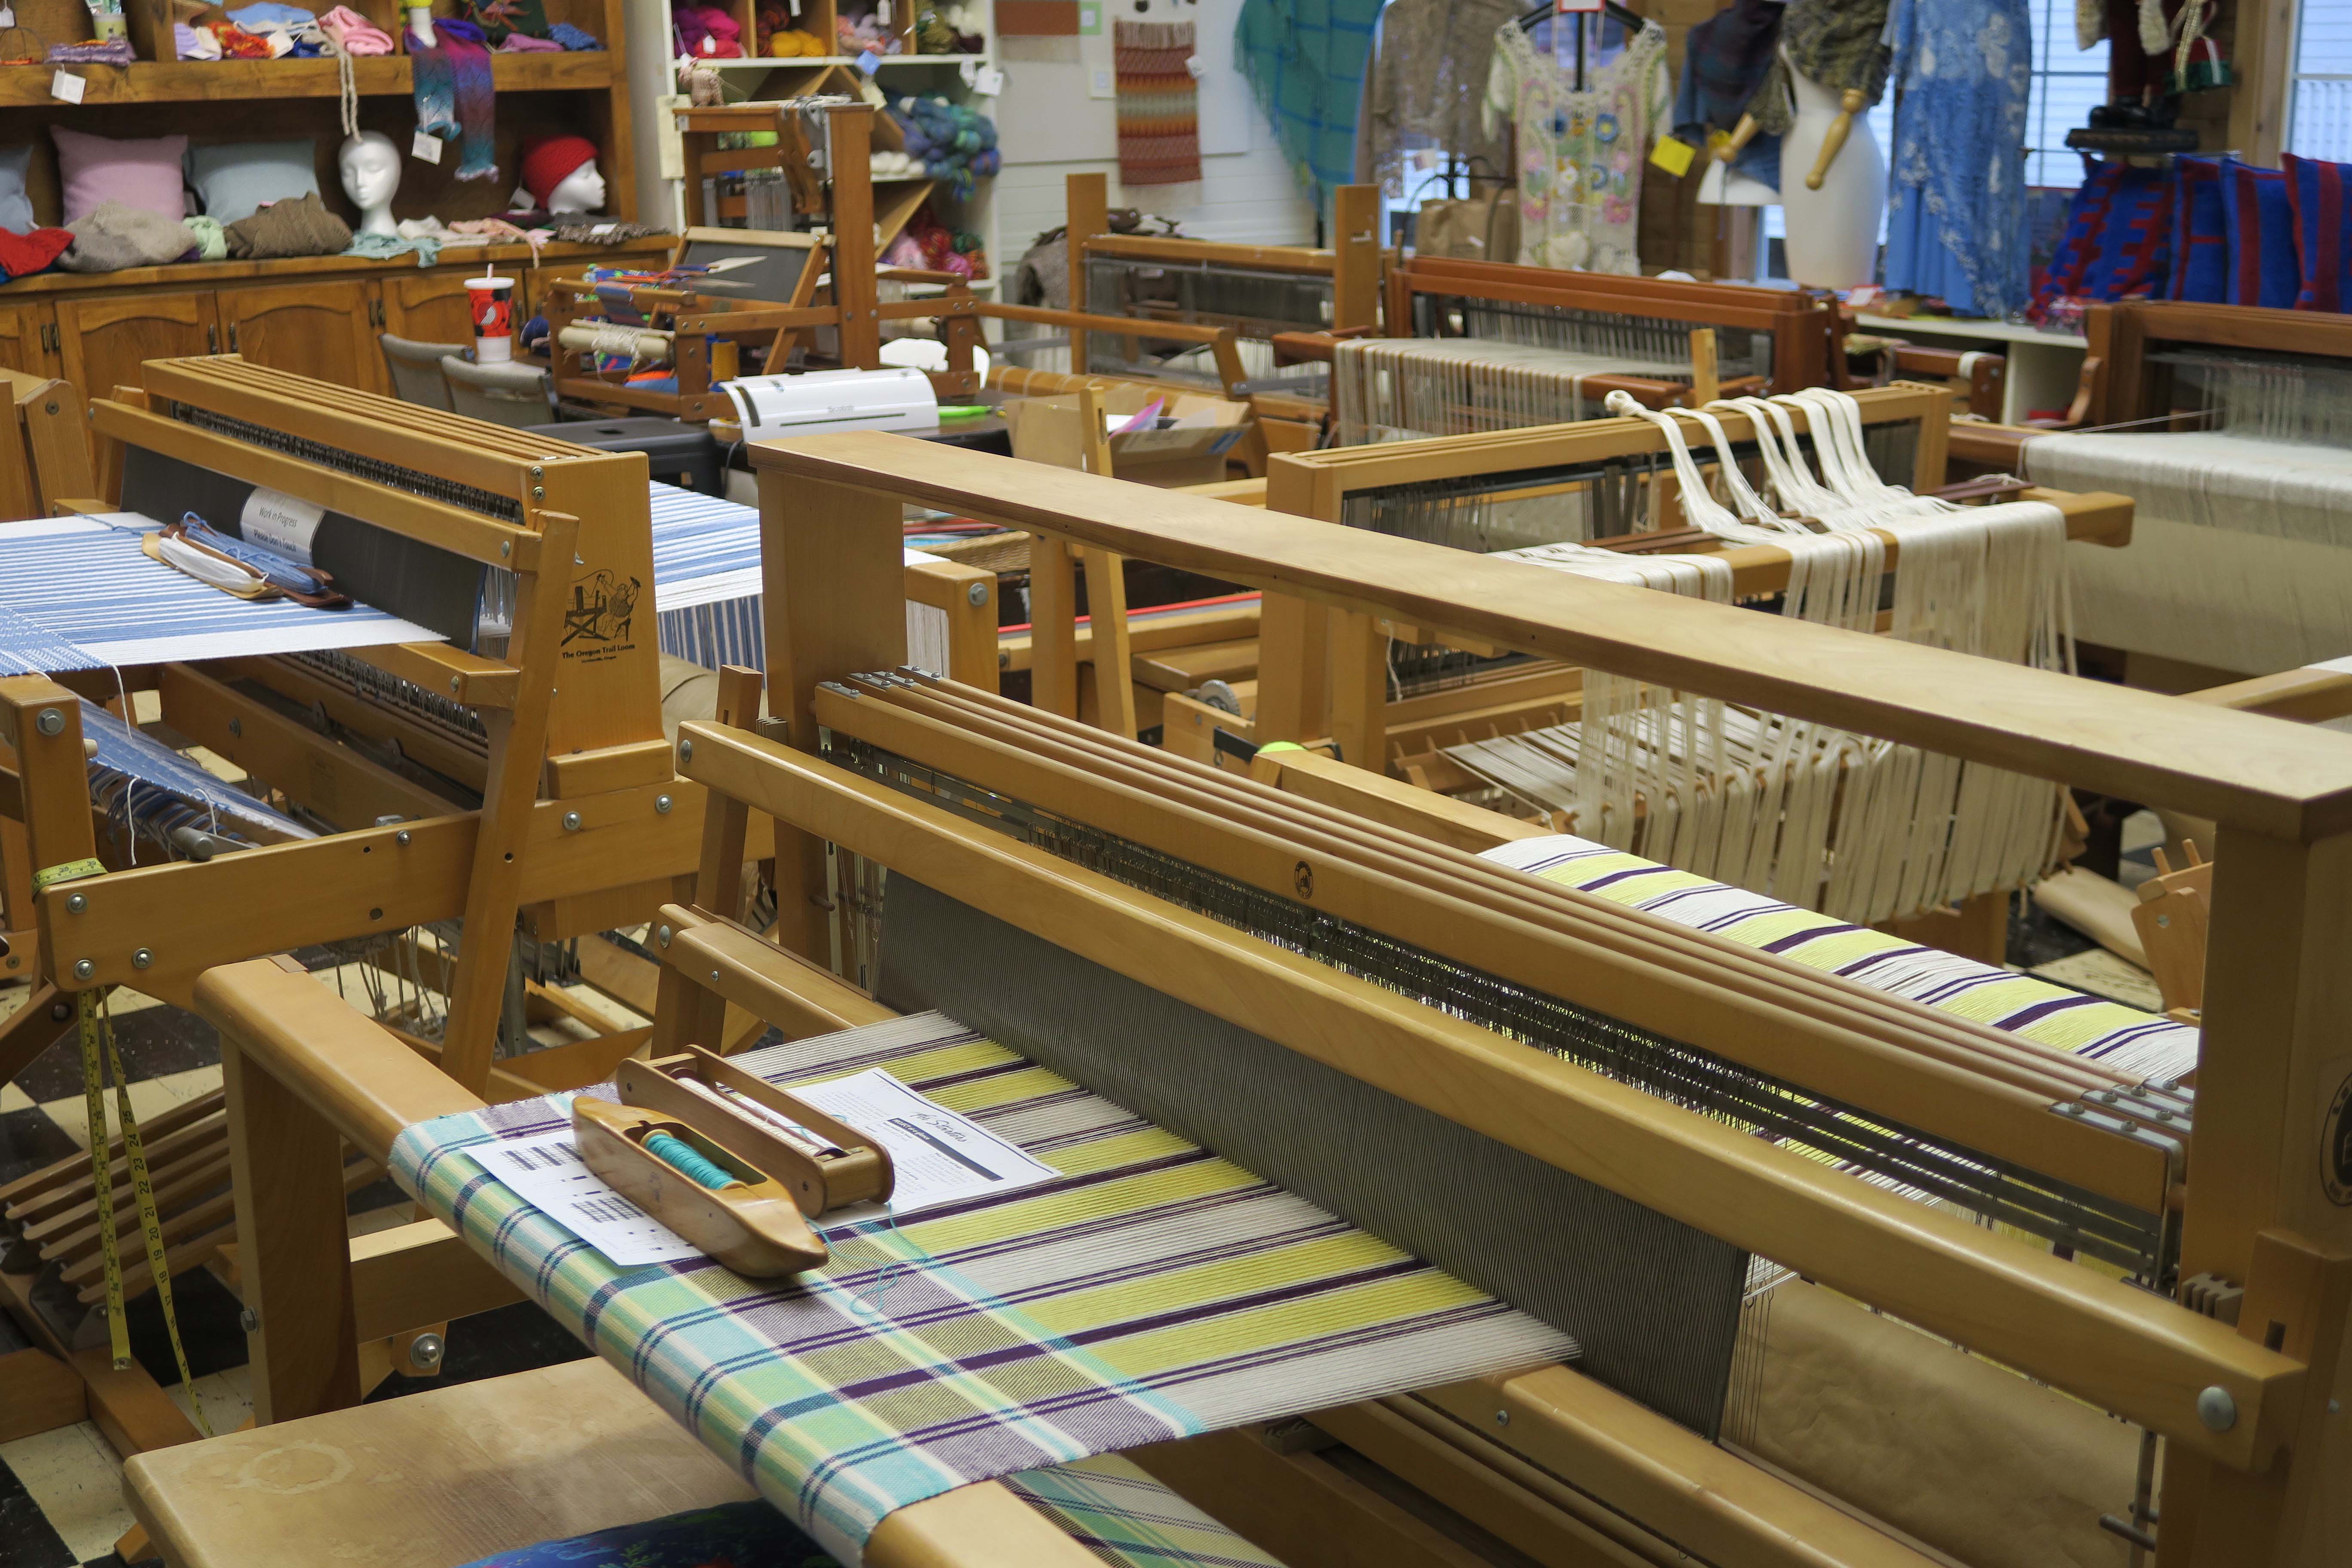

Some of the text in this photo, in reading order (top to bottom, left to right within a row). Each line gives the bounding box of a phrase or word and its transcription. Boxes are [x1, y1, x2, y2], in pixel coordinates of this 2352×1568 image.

[259, 506, 298, 528] Work in Progress
[254, 530, 269, 542] Please
[282, 538, 297, 552] Touch
[113, 1060, 122, 1074] 27
[119, 1084, 128, 1099] 26
[123, 1111, 133, 1124] 25
[909, 1111, 937, 1121] For
[925, 1120, 968, 1142] Starters
[128, 1134, 139, 1147] 24
[133, 1158, 144, 1171] 23
[138, 1180, 149, 1194] 22
[144, 1207, 155, 1218] 21
[149, 1227, 159, 1241] 20
[153, 1249, 163, 1261] 19
[159, 1271, 168, 1283] 18
[165, 1295, 171, 1306] 17
[171, 1317, 175, 1329] 16
